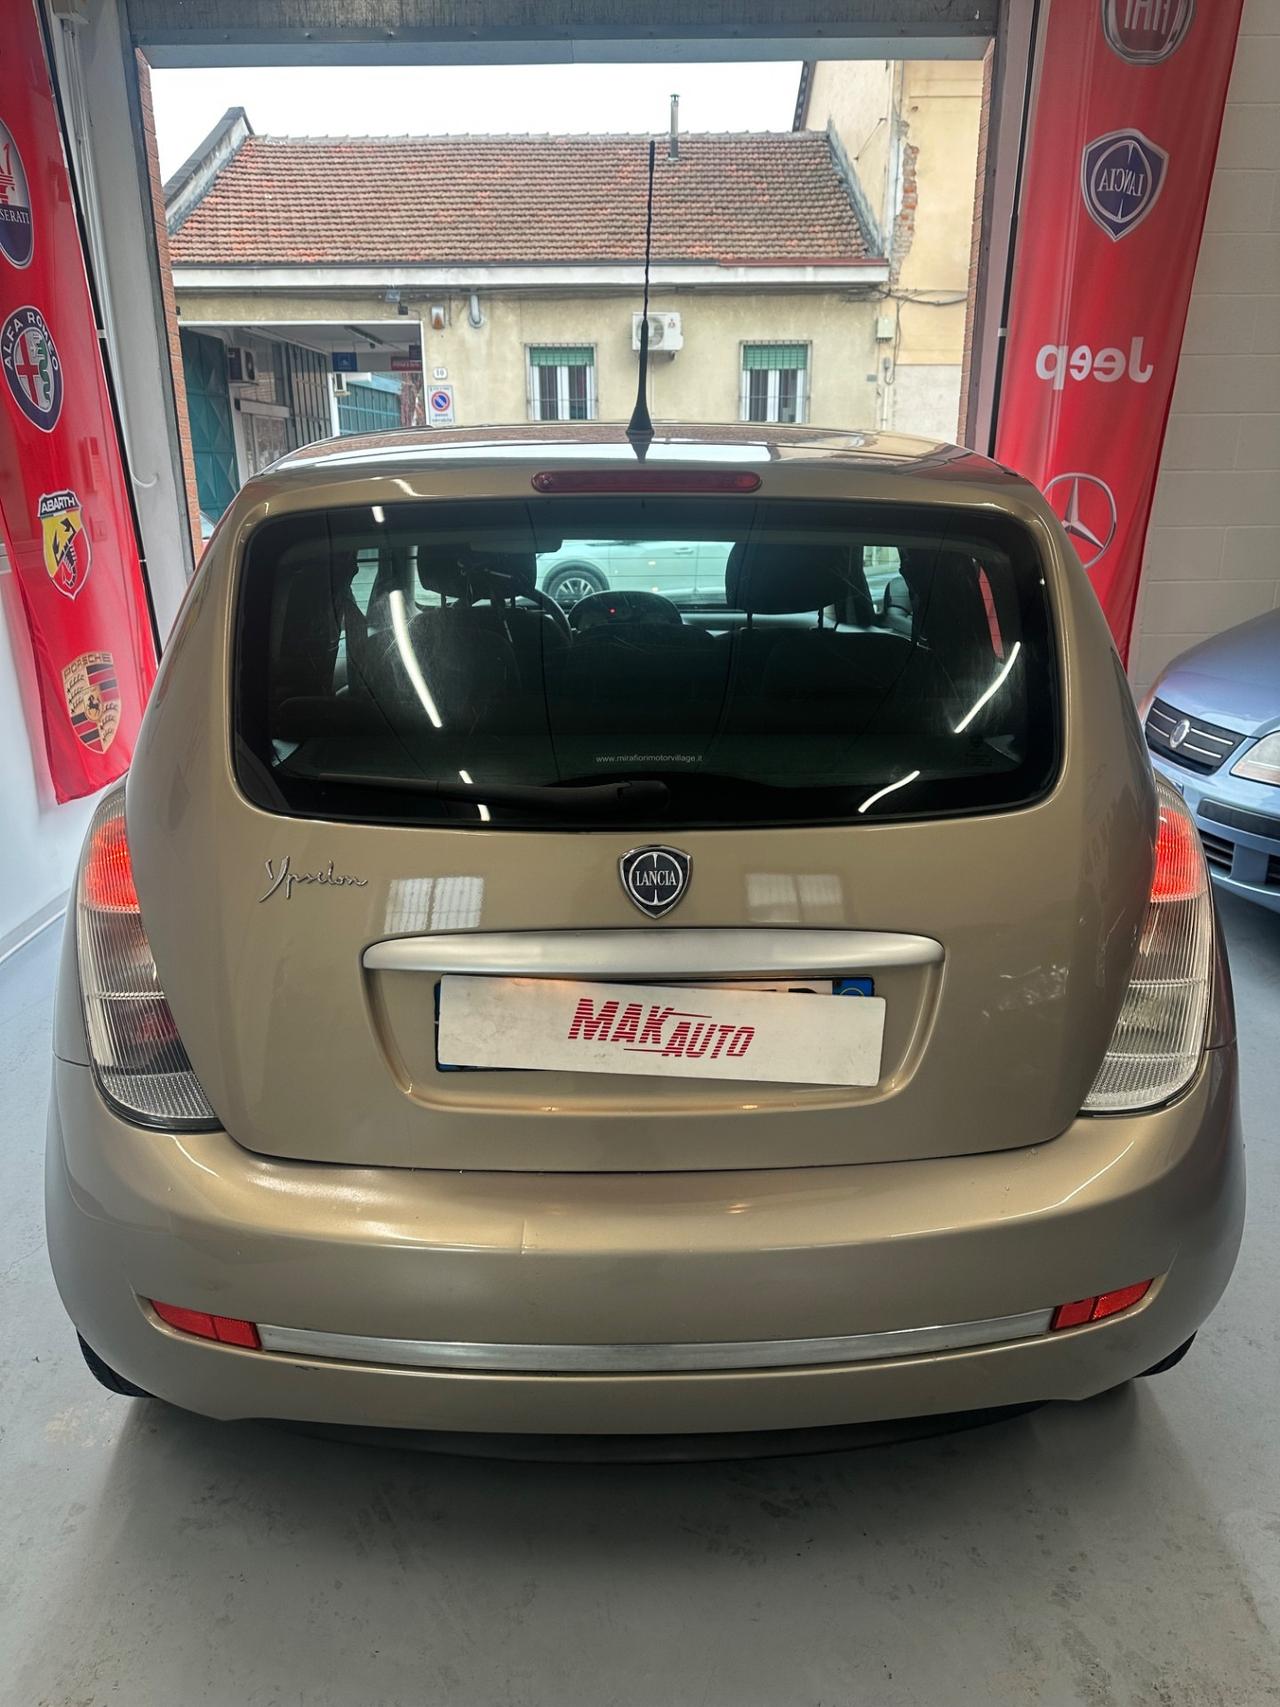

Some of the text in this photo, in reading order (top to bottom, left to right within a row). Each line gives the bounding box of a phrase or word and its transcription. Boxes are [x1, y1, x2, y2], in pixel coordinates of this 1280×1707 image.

[3, 311, 59, 371] ALFA ROMEO
[41, 496, 76, 513] ABARTH
[63, 653, 111, 681] PORSCHE
[259, 855, 369, 903] Ypsilon
[636, 870, 677, 886] LANCIA
[567, 998, 756, 1059] MAK AUTO
